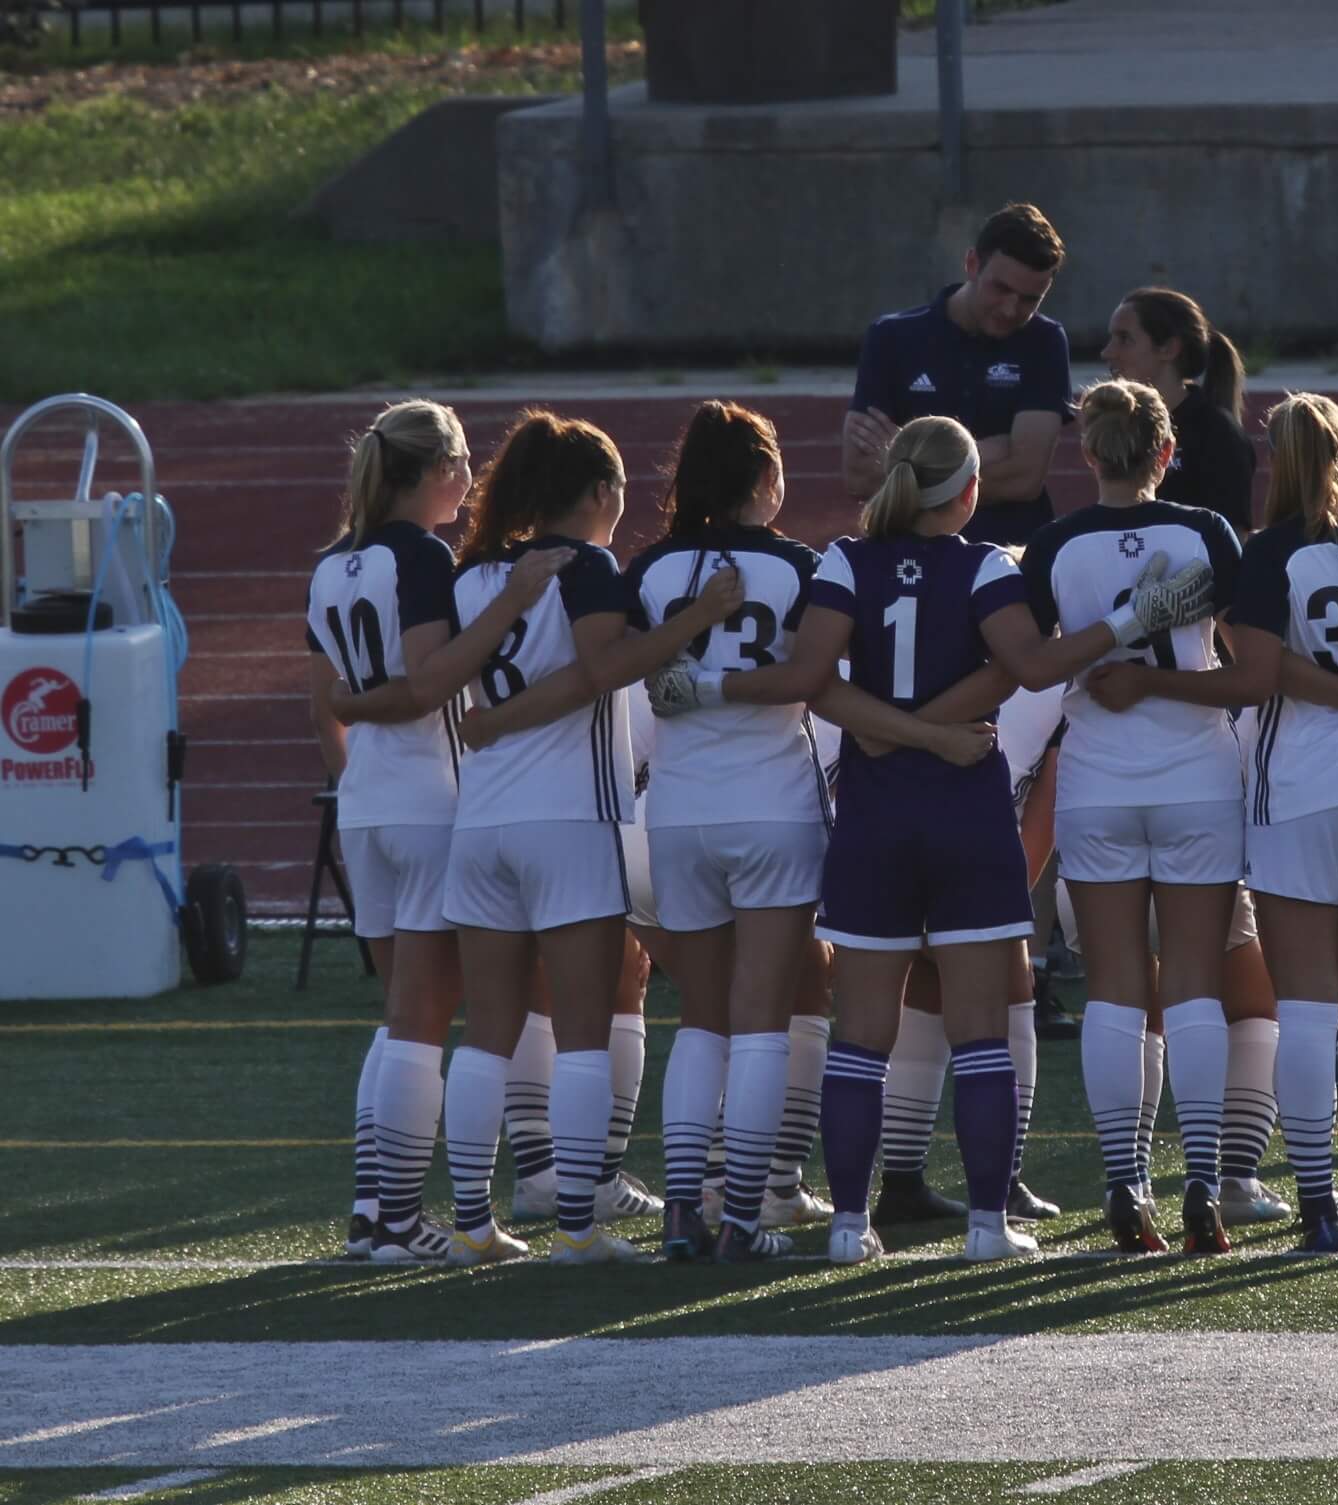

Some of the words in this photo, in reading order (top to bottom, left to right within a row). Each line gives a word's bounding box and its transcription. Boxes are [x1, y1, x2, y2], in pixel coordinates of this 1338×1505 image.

[326, 597, 389, 694] 10
[481, 617, 528, 707] 8
[883, 595, 918, 699] 1
[10, 701, 78, 743] Cramer
